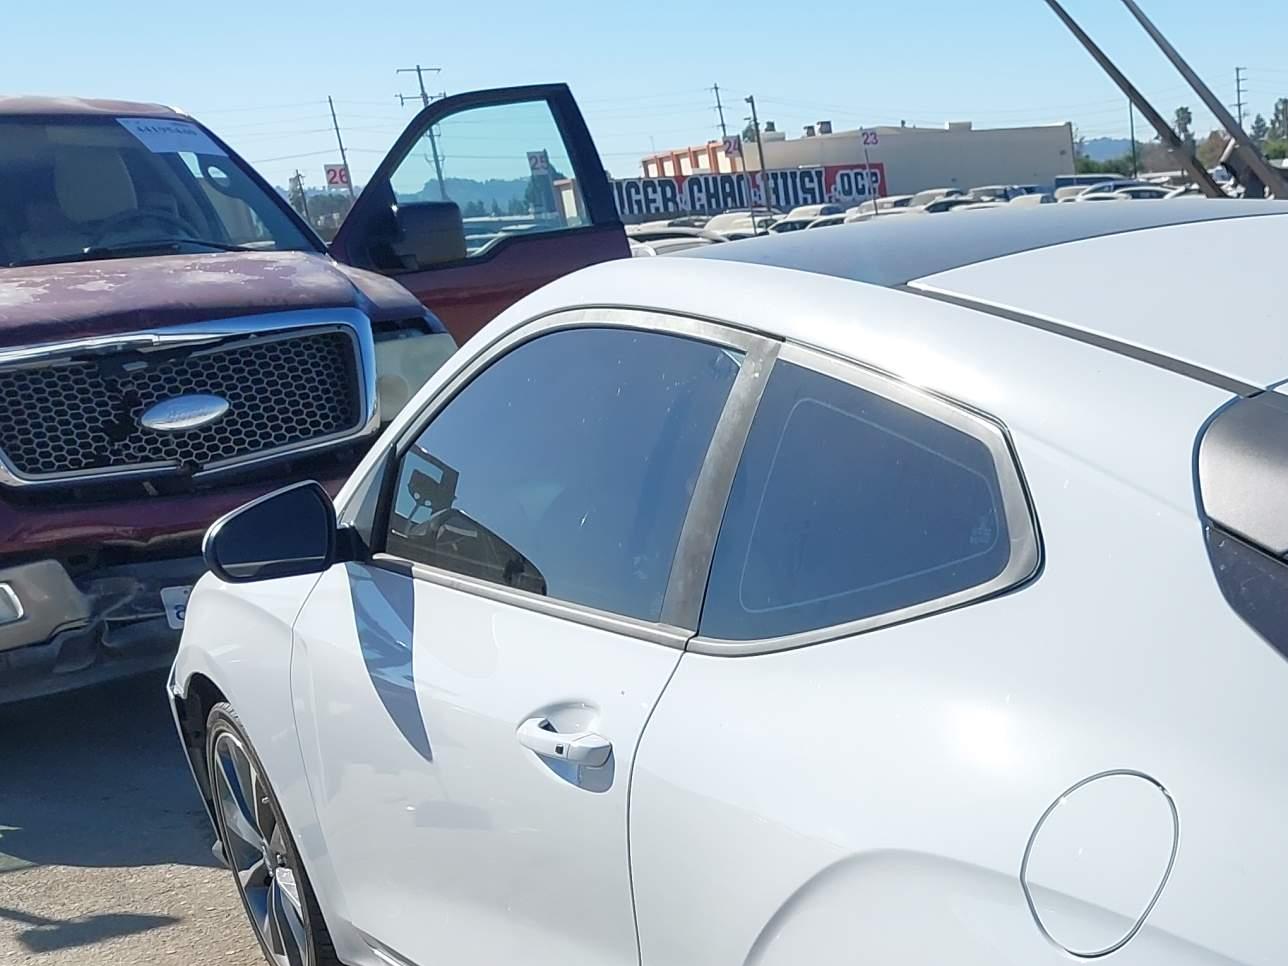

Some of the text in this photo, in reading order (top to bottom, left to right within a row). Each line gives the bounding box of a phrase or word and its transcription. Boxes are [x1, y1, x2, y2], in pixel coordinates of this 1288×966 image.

[862, 132, 878, 145] 23
[724, 139, 740, 154] 24
[327, 168, 349, 184] 26
